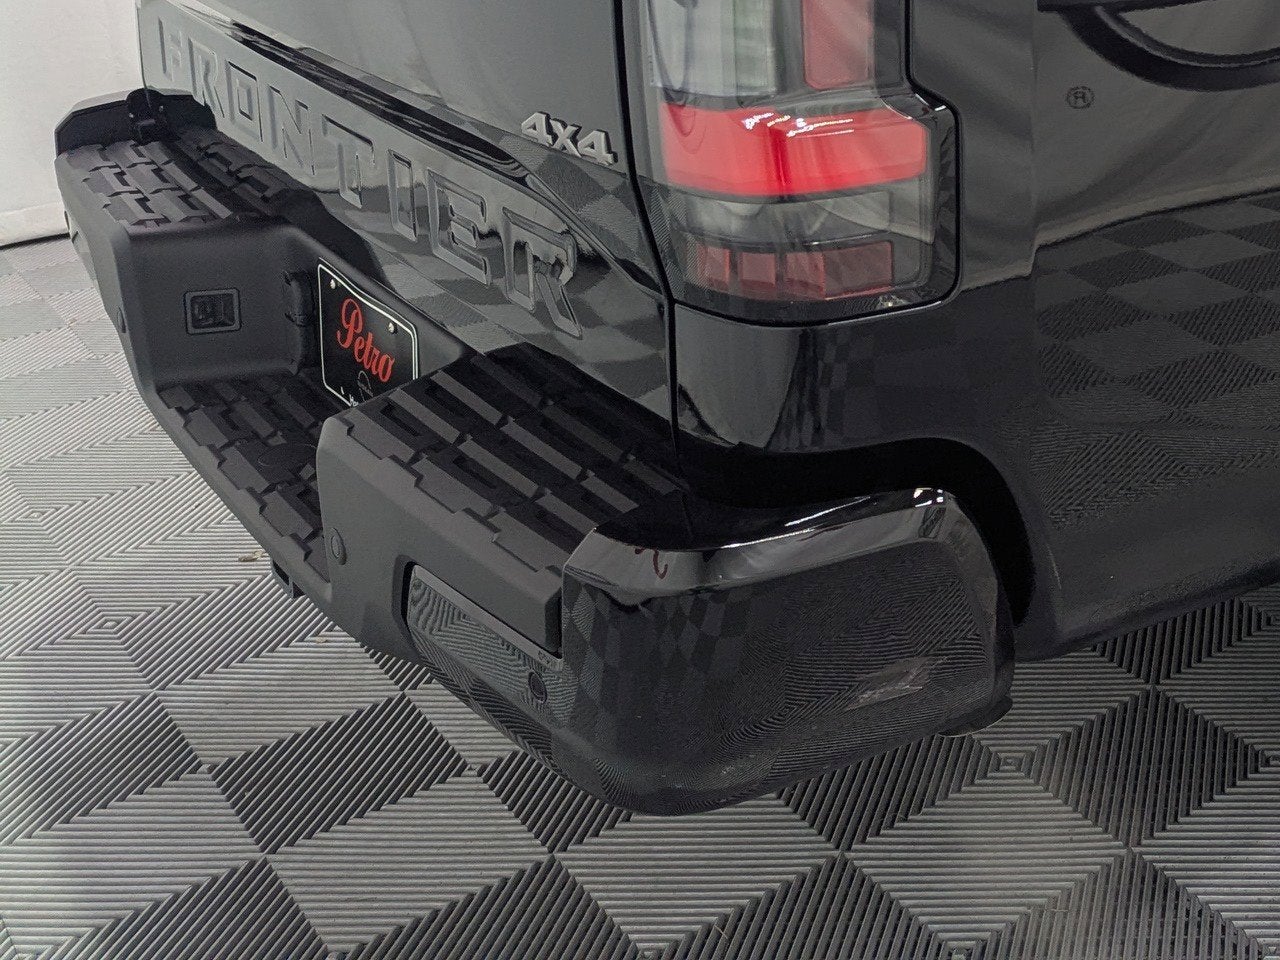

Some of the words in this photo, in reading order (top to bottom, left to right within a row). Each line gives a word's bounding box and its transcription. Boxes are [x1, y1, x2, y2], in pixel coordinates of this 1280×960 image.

[158, 17, 583, 340] FRONTIER
[520, 111, 618, 166] 4X4
[336, 298, 396, 383] Petro
